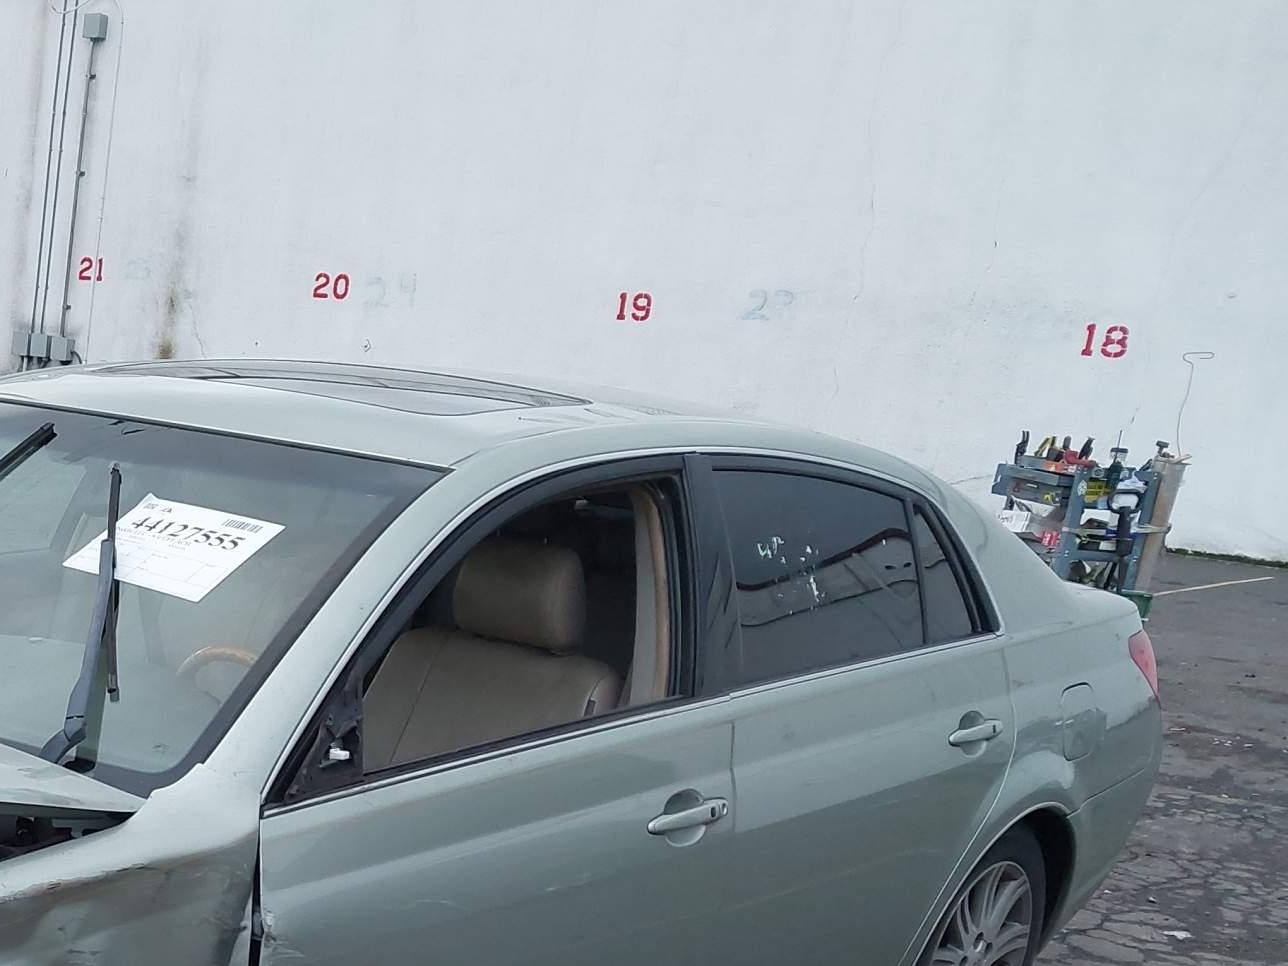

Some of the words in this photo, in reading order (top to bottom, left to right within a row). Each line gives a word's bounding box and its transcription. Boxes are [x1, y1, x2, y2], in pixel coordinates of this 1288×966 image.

[78, 256, 104, 282] 21
[312, 273, 350, 301] 20
[616, 290, 653, 321] 19
[1081, 323, 1130, 359] 18
[131, 516, 247, 550] 44127555
